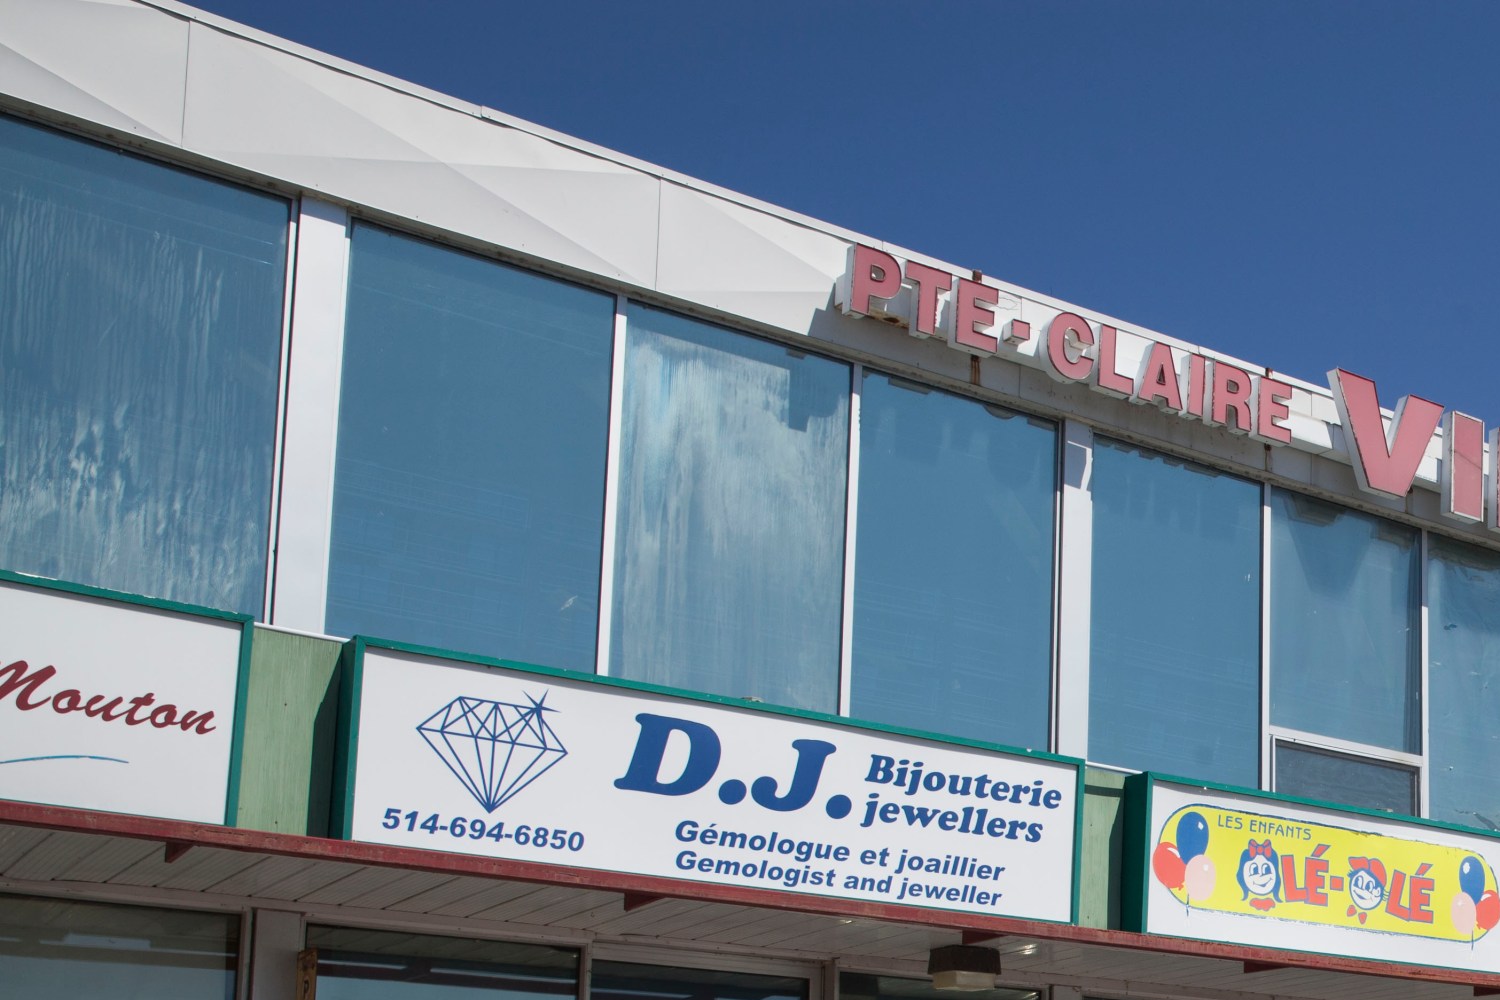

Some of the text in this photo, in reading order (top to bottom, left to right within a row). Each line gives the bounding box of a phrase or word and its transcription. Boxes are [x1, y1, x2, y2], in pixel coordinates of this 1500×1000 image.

[0, 660, 217, 735] Mouton
[613, 712, 852, 820] D.J.
[863, 754, 1063, 810] Bijouterie
[382, 808, 585, 852] 514-694-6850
[860, 793, 1044, 843] jewellers
[1217, 814, 1312, 841] LES ENFANTS
[674, 819, 1006, 882] Gémologue et joaillier
[674, 850, 1003, 907] Gemologist and jeweller
